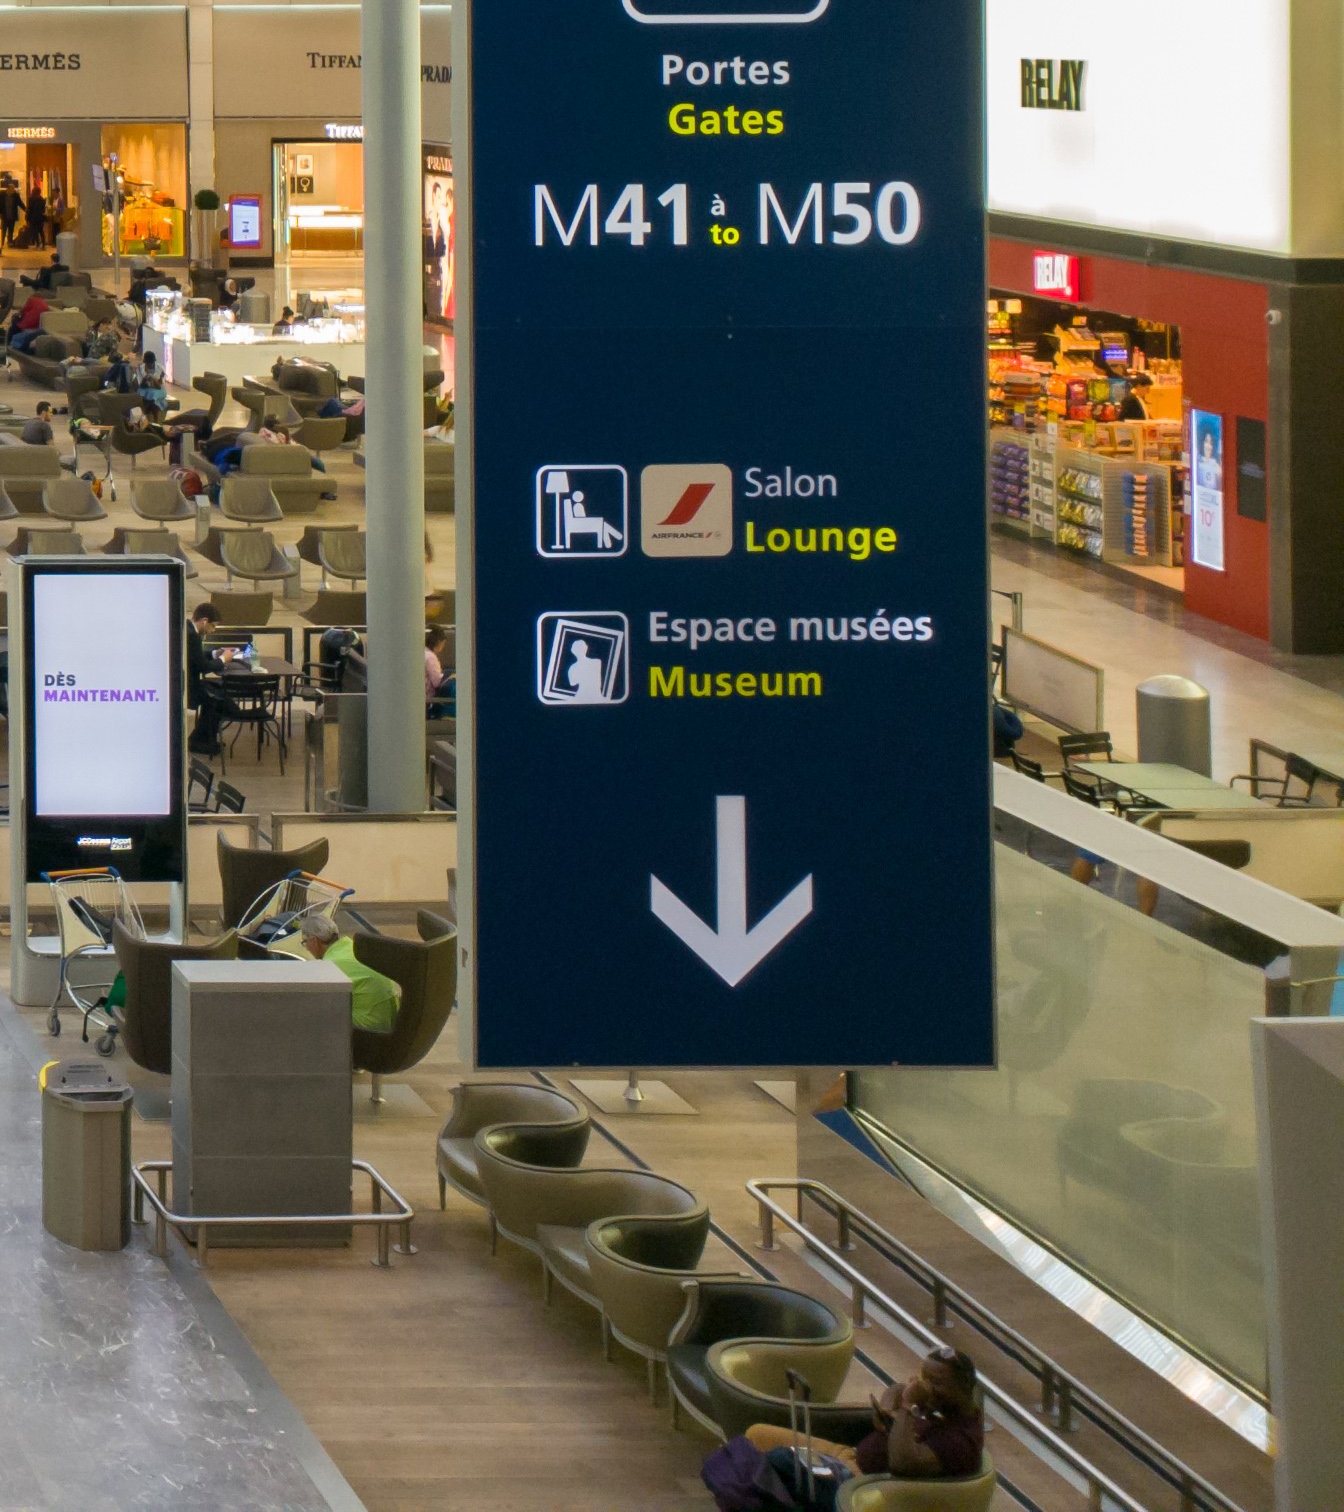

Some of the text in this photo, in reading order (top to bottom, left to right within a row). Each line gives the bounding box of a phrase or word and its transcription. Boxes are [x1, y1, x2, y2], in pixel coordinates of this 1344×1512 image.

[662, 54, 791, 88] Portes
[1020, 58, 1087, 112] RELAY
[669, 105, 784, 136] Gates
[534, 182, 921, 247] M41 à M50
[710, 224, 740, 245] to
[1034, 254, 1070, 290] RELAY
[745, 466, 837, 498] Salon
[746, 522, 897, 560] Lounge
[648, 607, 932, 650] Espace musées
[44, 672, 76, 687] DÈS
[44, 689, 160, 702] MAINTENANT.
[649, 667, 822, 698] Museum
